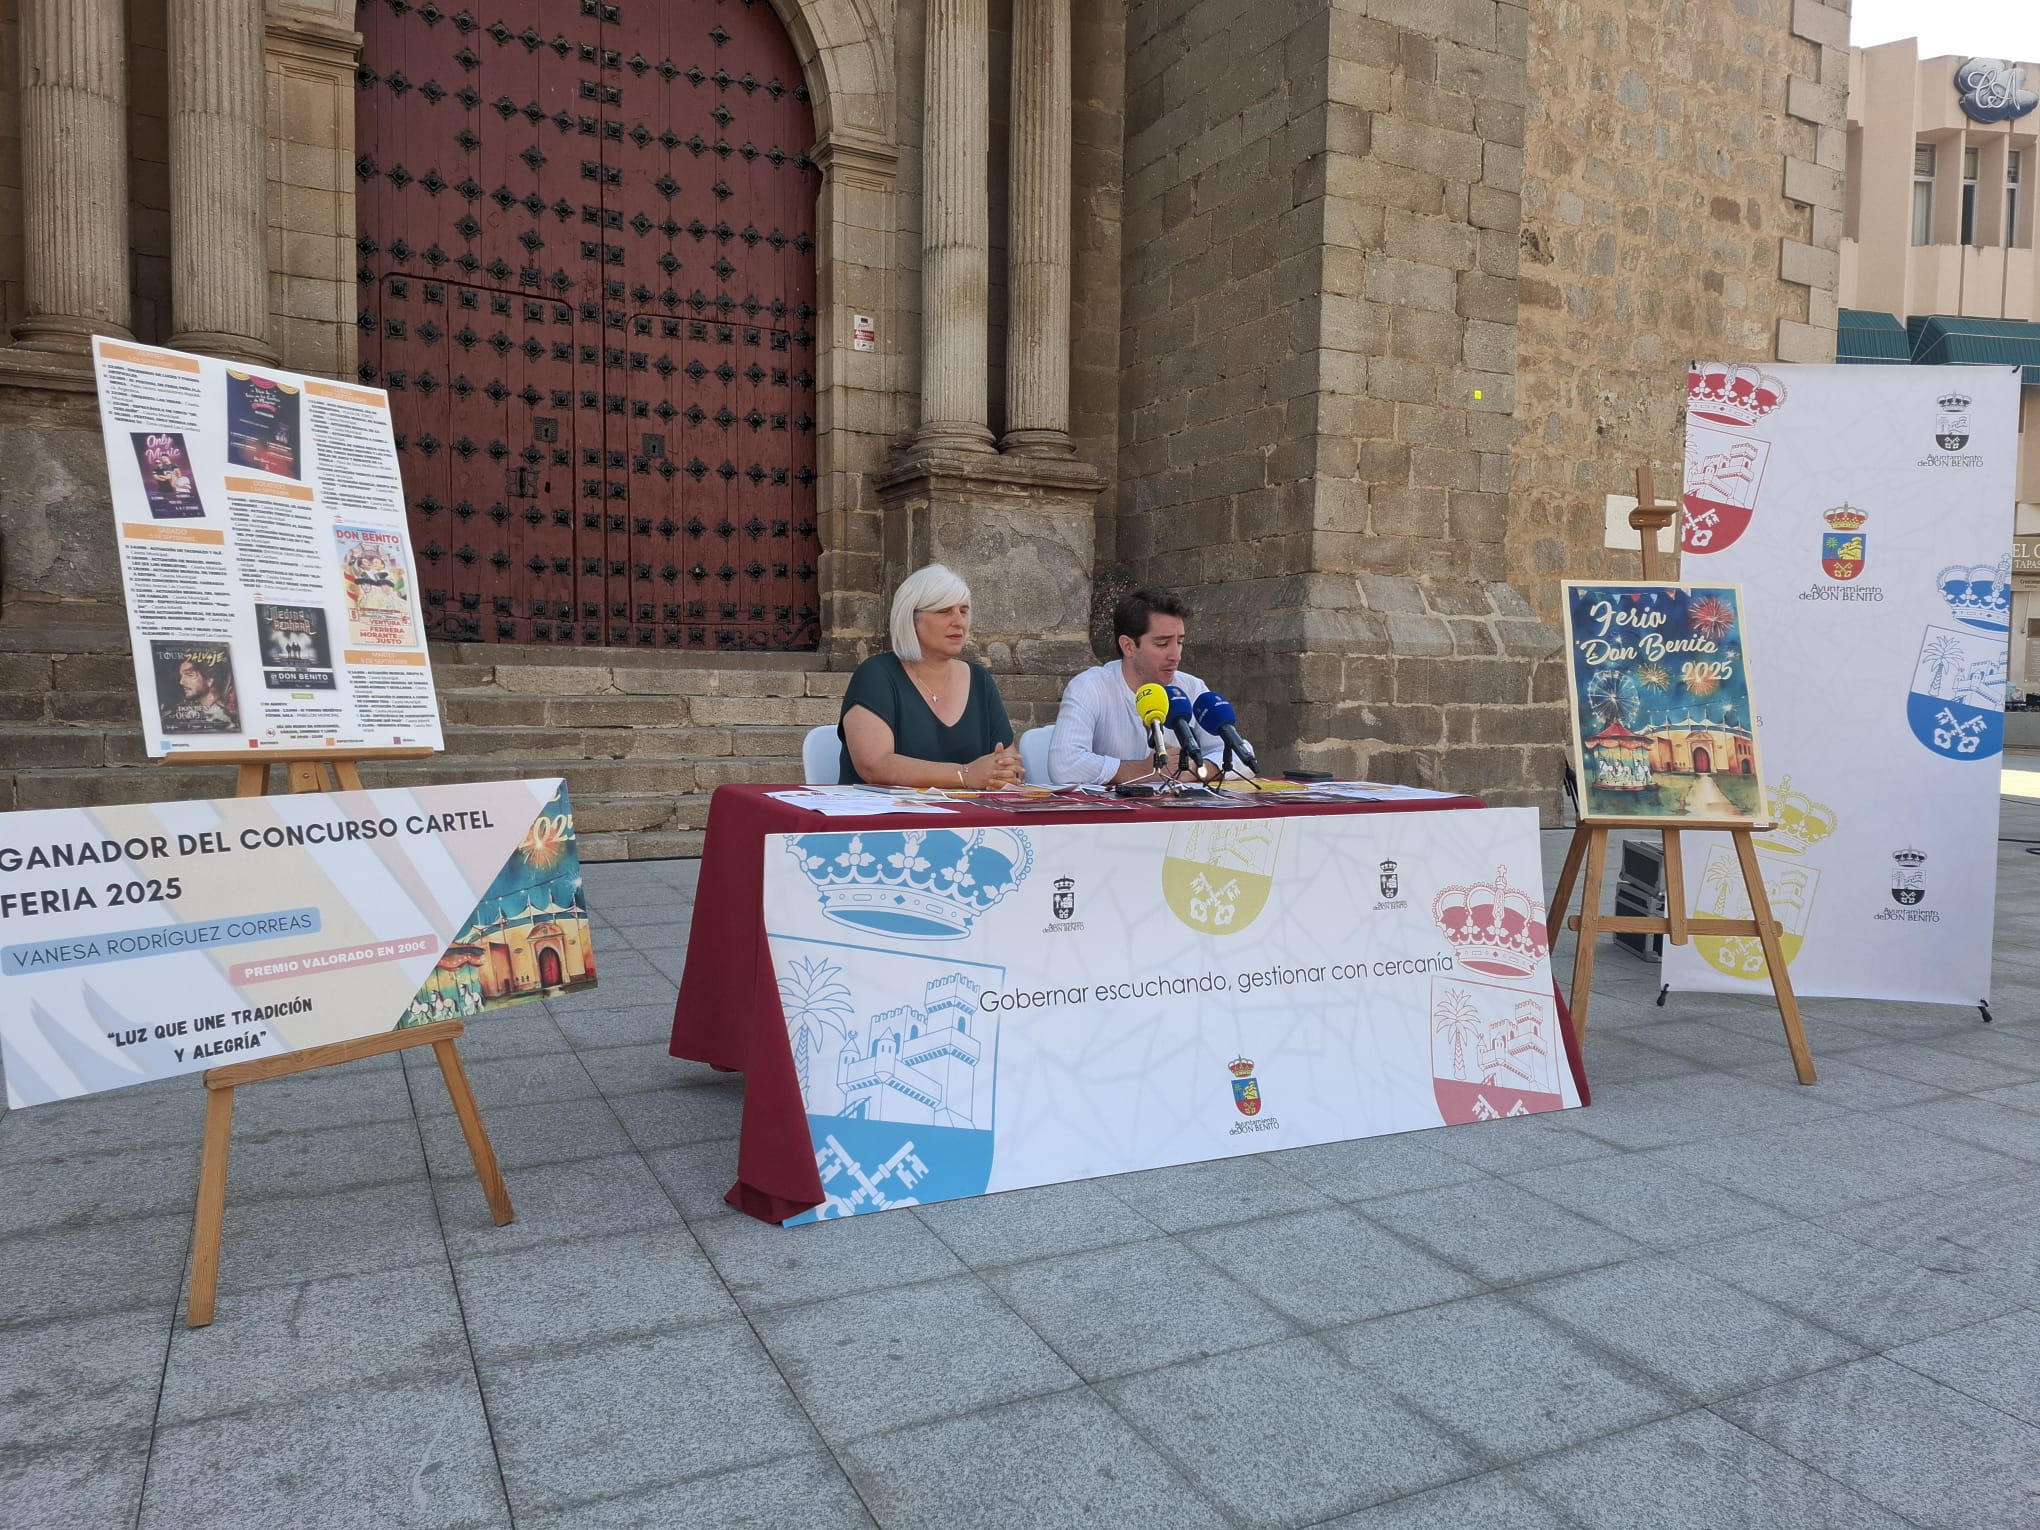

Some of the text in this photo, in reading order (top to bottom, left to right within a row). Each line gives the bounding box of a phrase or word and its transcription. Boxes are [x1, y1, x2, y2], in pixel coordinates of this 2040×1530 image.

[147, 433, 173, 449] Only
[1927, 453, 1983, 461] Ayuntamiento
[336, 529, 400, 544] DON BENITO
[1810, 584, 1882, 593] Ayuntamiento
[1842, 592, 1884, 601] BENITO
[1590, 601, 1667, 637] Feria
[1580, 633, 1718, 665] Don Benito
[279, 672, 297, 680] DON
[298, 673, 328, 681] BENITO
[1681, 661, 1733, 682] 2025
[0, 810, 494, 872] GANADOR DEL CONCURSO CARTEL
[0, 877, 183, 919] FERIA 2025
[1882, 907, 1939, 916] Ayuntamiento
[1907, 914, 1940, 923] BENITO
[12, 913, 312, 968] VANESA RODRÍGUEZ CORREAS
[244, 940, 427, 979] PREMIO VALORADO EN 200€
[979, 951, 1453, 1012] Gobernar escuchando, gestionar con cercanía
[106, 996, 313, 1048] “LUZ QUE UNE TRADICIÓN
[173, 1030, 267, 1063] Y ALEGRÍA”
[1254, 1121, 1280, 1132] BENITO
